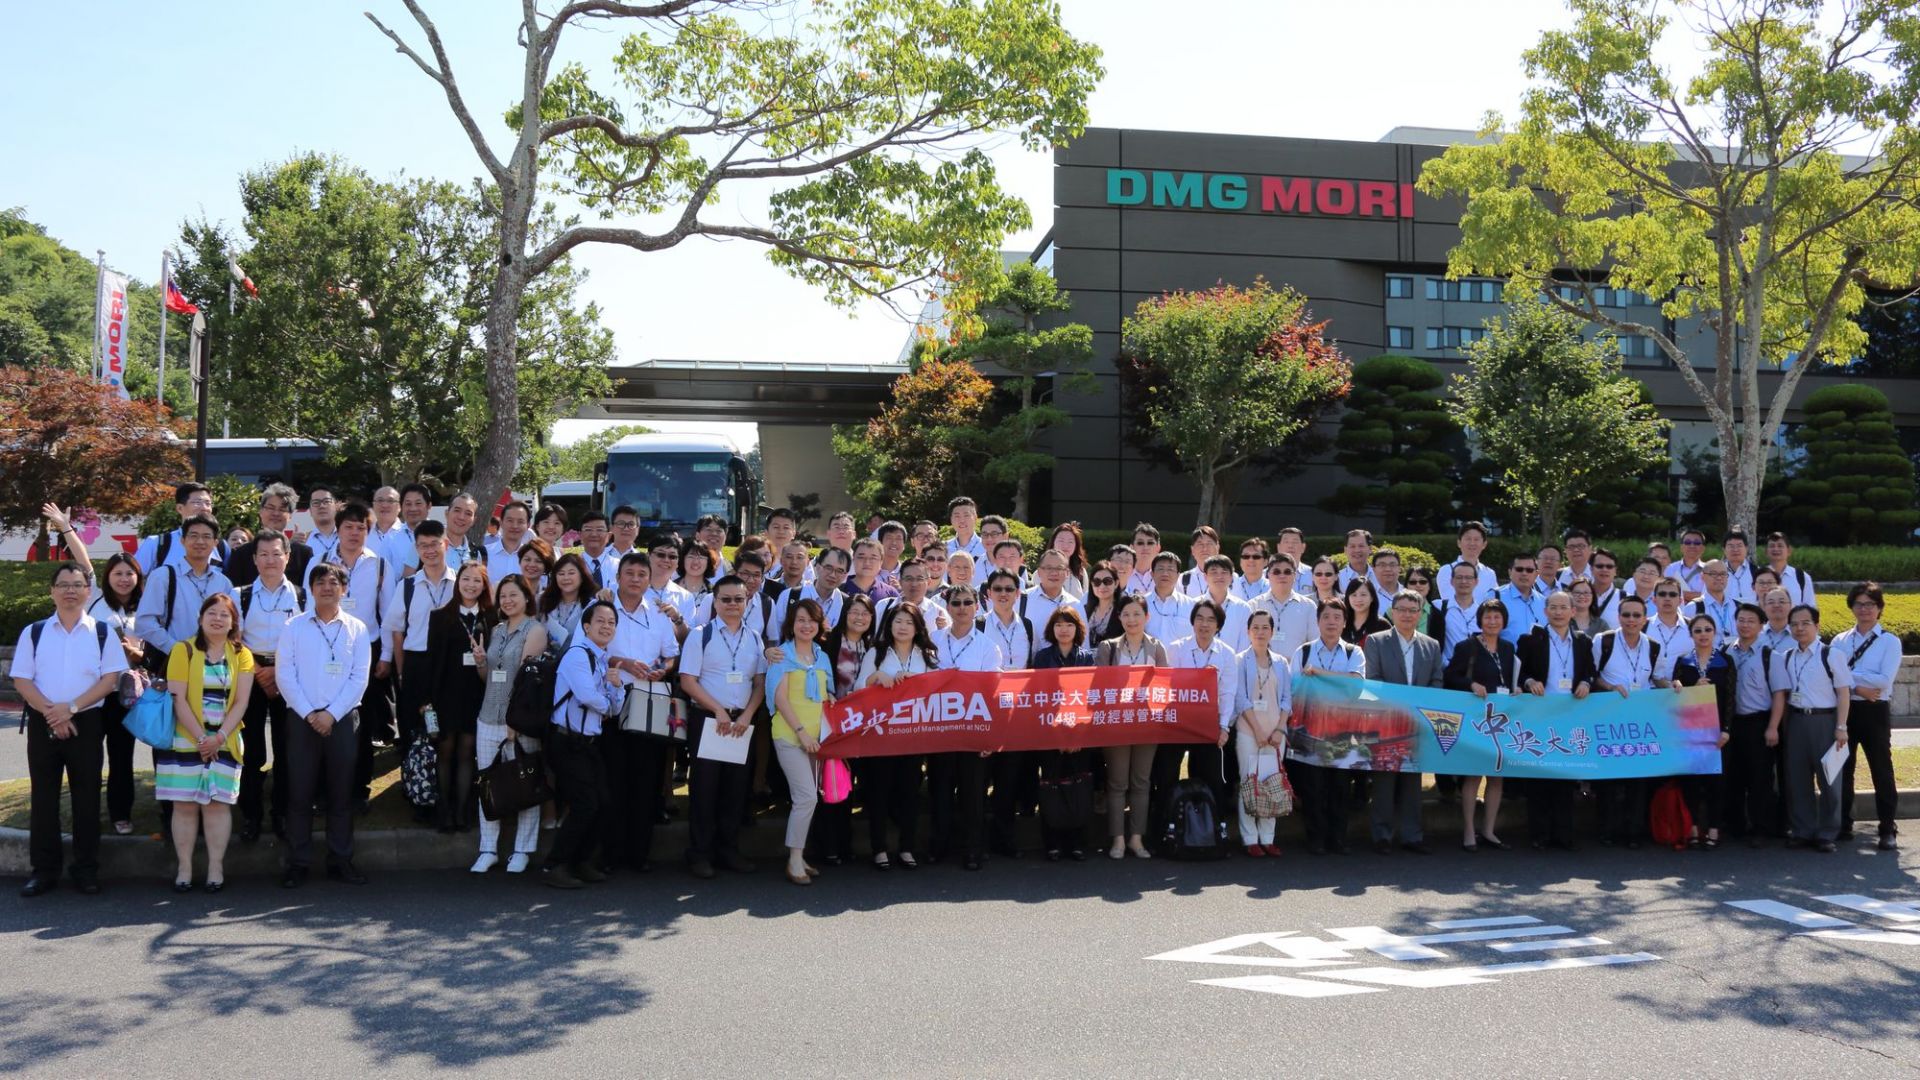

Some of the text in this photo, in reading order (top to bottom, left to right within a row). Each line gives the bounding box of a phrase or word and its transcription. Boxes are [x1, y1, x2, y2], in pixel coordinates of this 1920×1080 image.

[1107, 168, 1414, 218] DMG MORI
[108, 290, 124, 373] MORI
[888, 692, 993, 725] EMBA
[1038, 708, 1178, 727] 104級一般經營管理組
[888, 726, 912, 735] School
[913, 725, 921, 733] of
[921, 723, 966, 734] Management
[974, 723, 991, 732] NCU
[1471, 701, 1592, 772] 中央大學
[1594, 721, 1658, 741] EMBA
[1507, 758, 1537, 767] National
